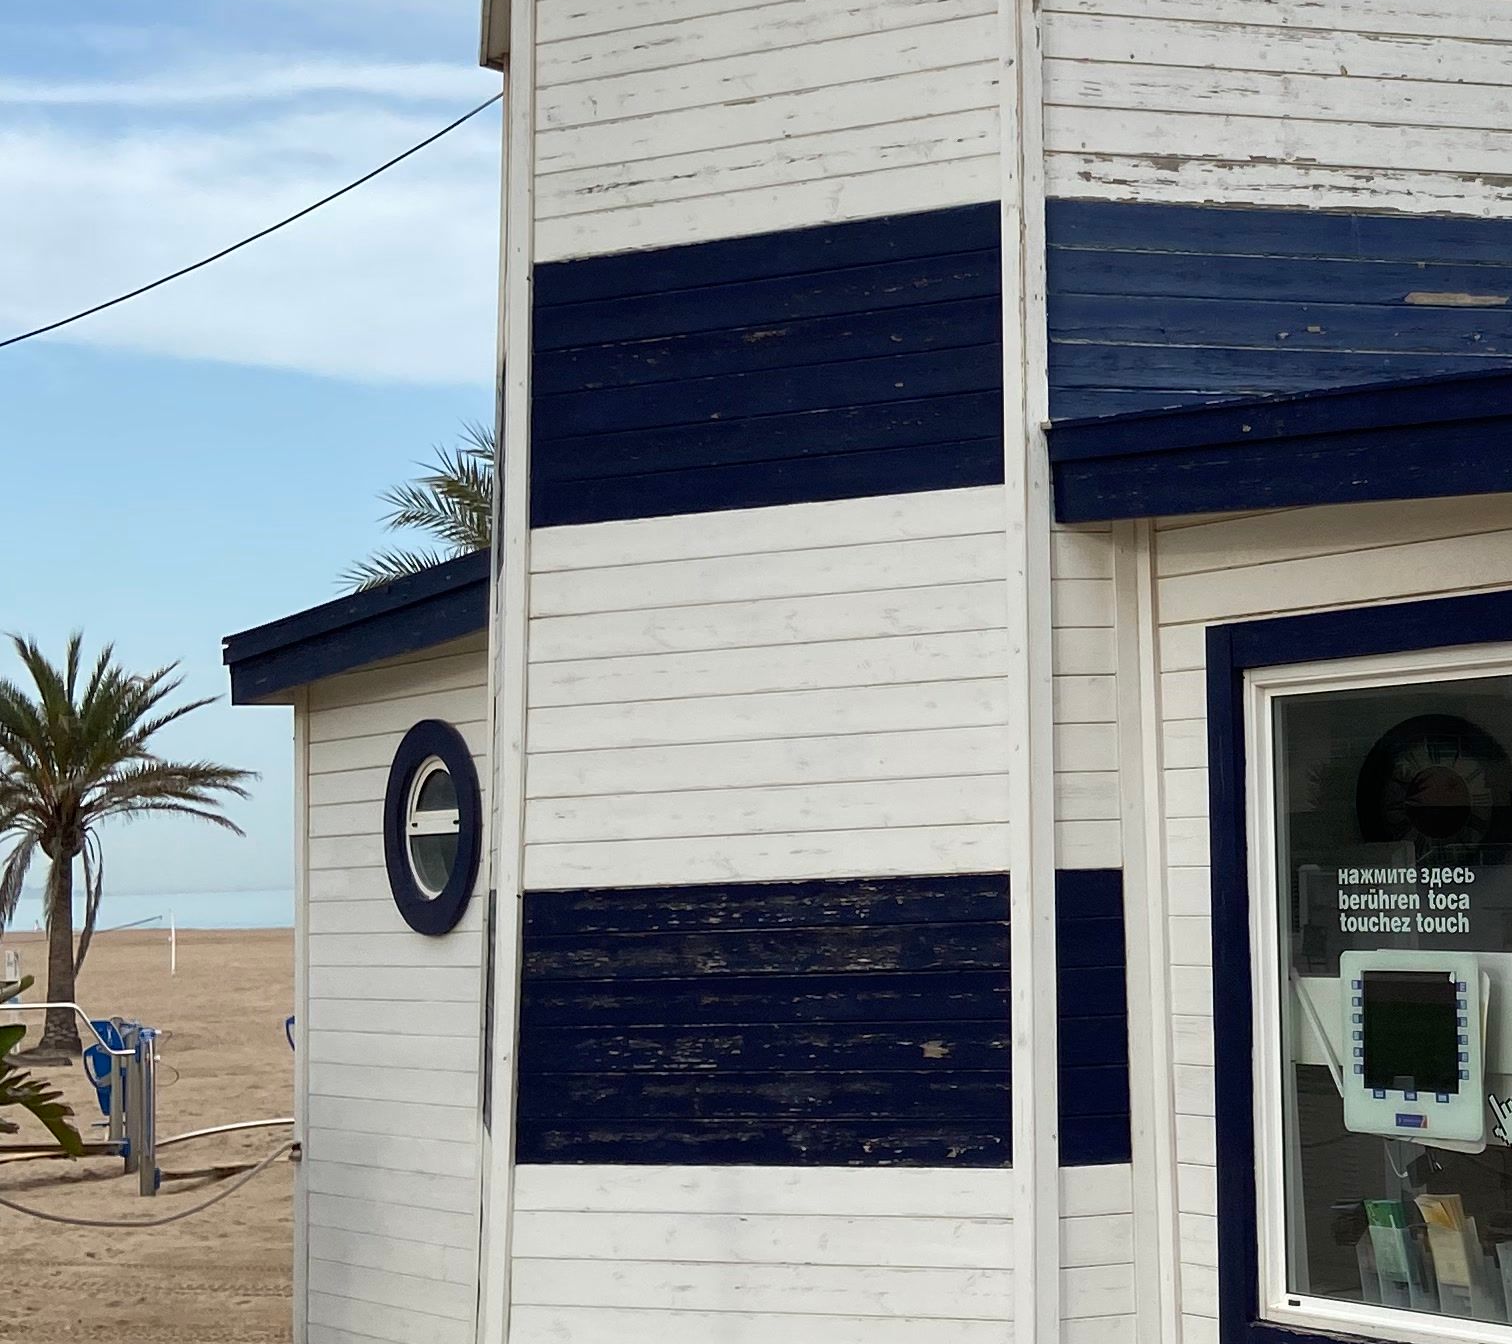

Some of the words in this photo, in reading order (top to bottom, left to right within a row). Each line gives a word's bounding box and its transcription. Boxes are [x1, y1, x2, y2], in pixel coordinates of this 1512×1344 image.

[1338, 867, 1417, 884] нажмите
[1420, 867, 1475, 888] здесь
[1338, 888, 1420, 910] berühren
[1427, 889, 1470, 910] toca
[1339, 912, 1411, 933] touchez
[1415, 912, 1470, 933] touch
